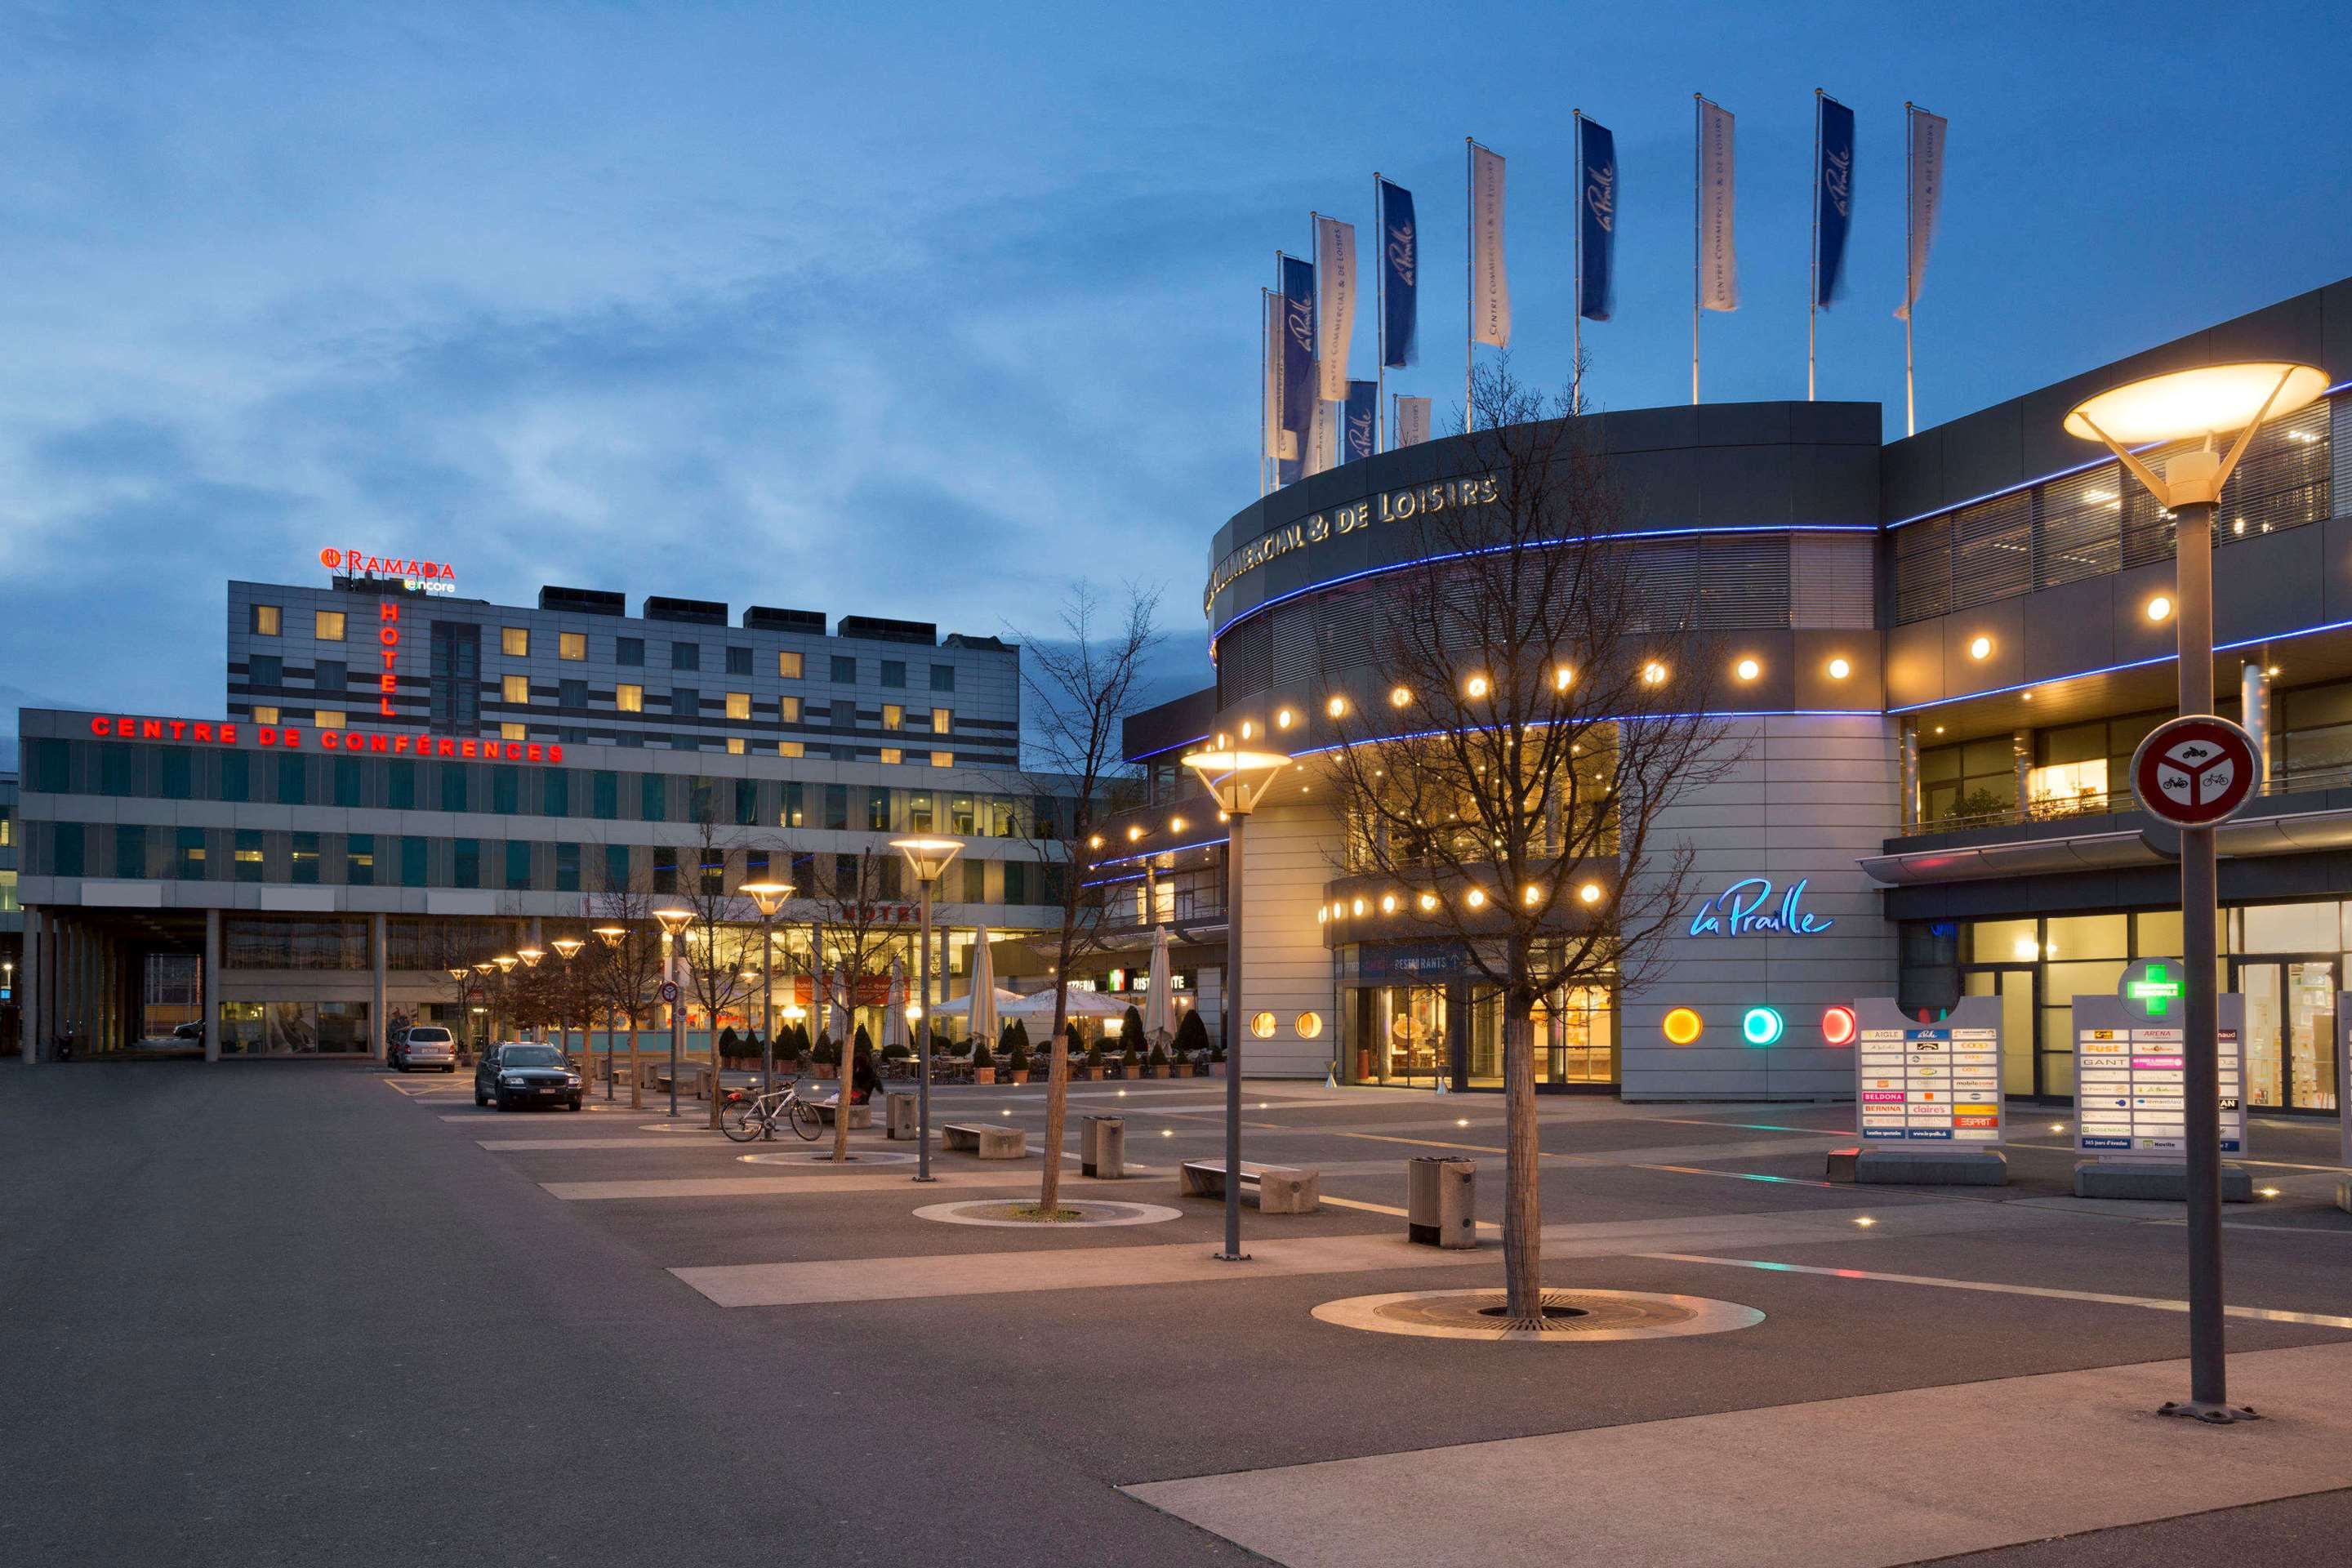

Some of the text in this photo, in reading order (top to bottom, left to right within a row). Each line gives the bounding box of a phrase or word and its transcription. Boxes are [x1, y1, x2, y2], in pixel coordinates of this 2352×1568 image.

[1307, 514, 1330, 543] &
[1334, 501, 1370, 534] DE
[1378, 474, 1498, 523] LOISIRS
[347, 549, 456, 580] RAMADA
[379, 603, 399, 718] HOTEL
[91, 716, 564, 763] CENTRE DE CONFÉRENCES
[1716, 877, 1833, 937] Praille
[1133, 975, 1184, 991] RISTTE
[1913, 1105, 1945, 1113] claire's
[1961, 1117, 1992, 1126] ESPRIT
